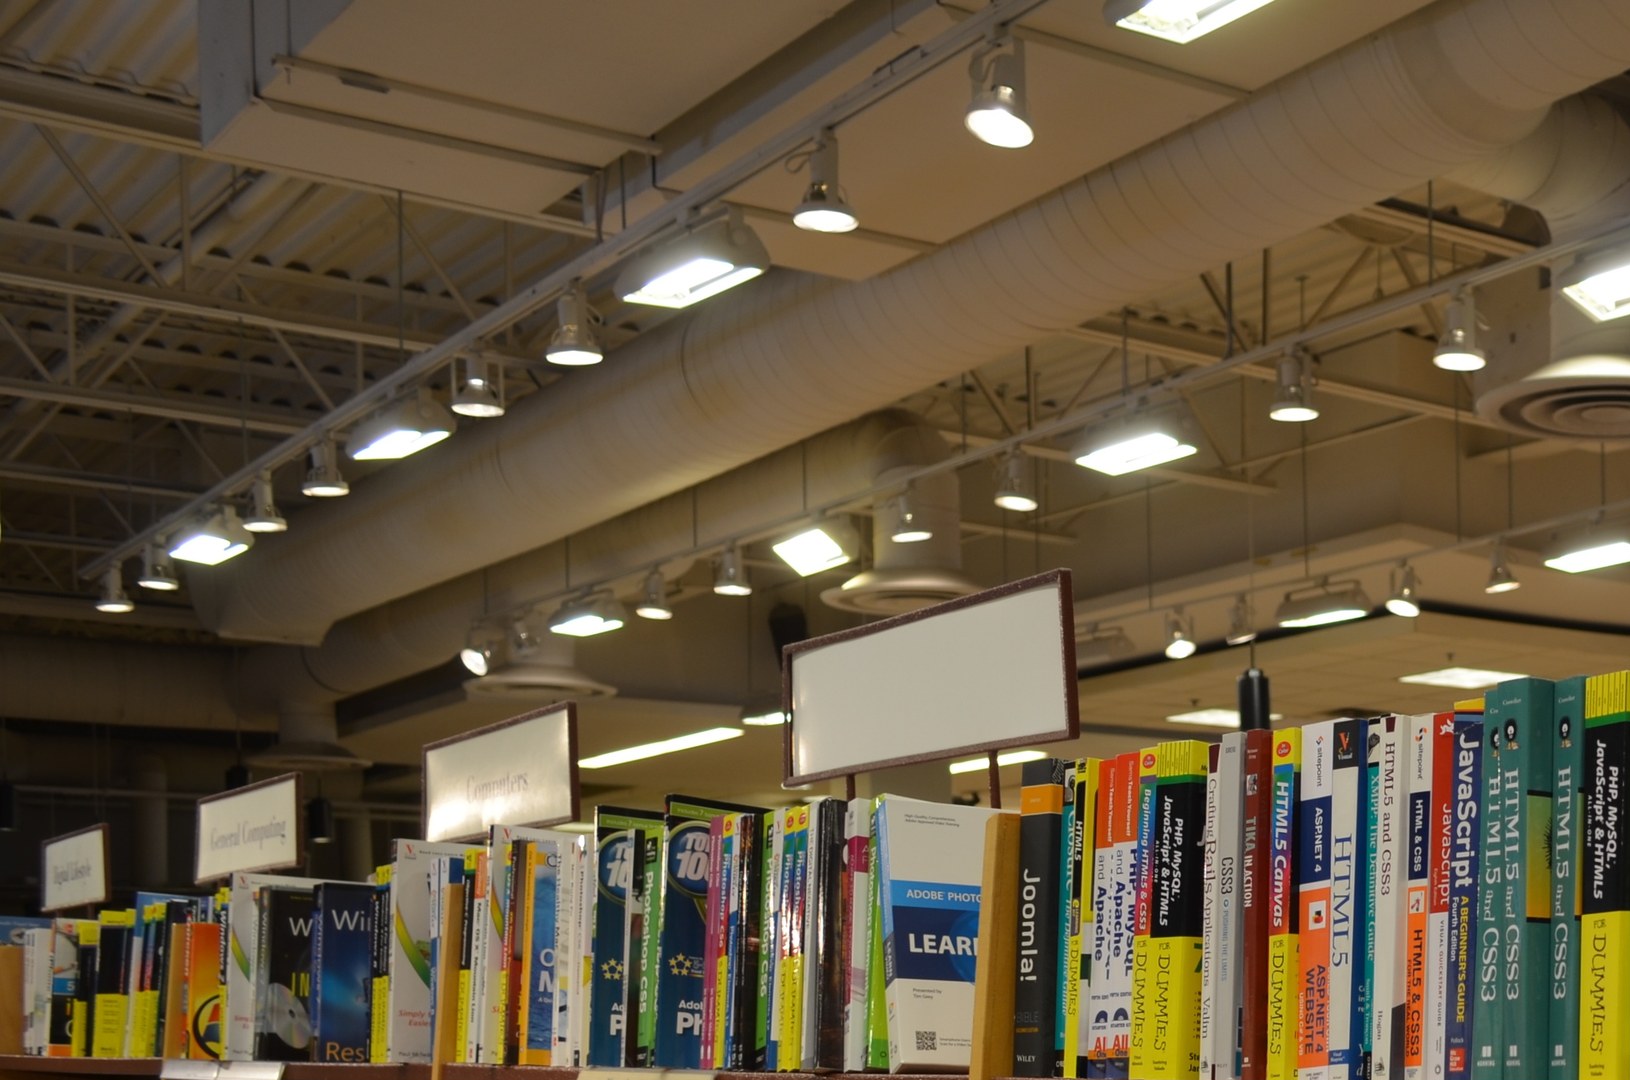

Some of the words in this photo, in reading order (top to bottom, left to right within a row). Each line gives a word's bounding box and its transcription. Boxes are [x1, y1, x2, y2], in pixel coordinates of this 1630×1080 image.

[1247, 816, 1256, 853] TIKA
[1277, 781, 1289, 861] HTML5
[1247, 855, 1253, 868] IN
[906, 889, 944, 900] ADOBE
[1244, 871, 1252, 907] ACTION
[1272, 869, 1286, 927] Canvas
[1332, 833, 1352, 966] HTML5
[641, 872, 654, 971] Photoshop
[909, 933, 978, 956] LEAR
[1021, 869, 1040, 982] Joomla!
[639, 977, 648, 1013] CS5
[1269, 953, 1287, 1055] DUMMIES
[1304, 968, 1316, 1054] WEBSITE
[1017, 1054, 1036, 1062] WILEY
